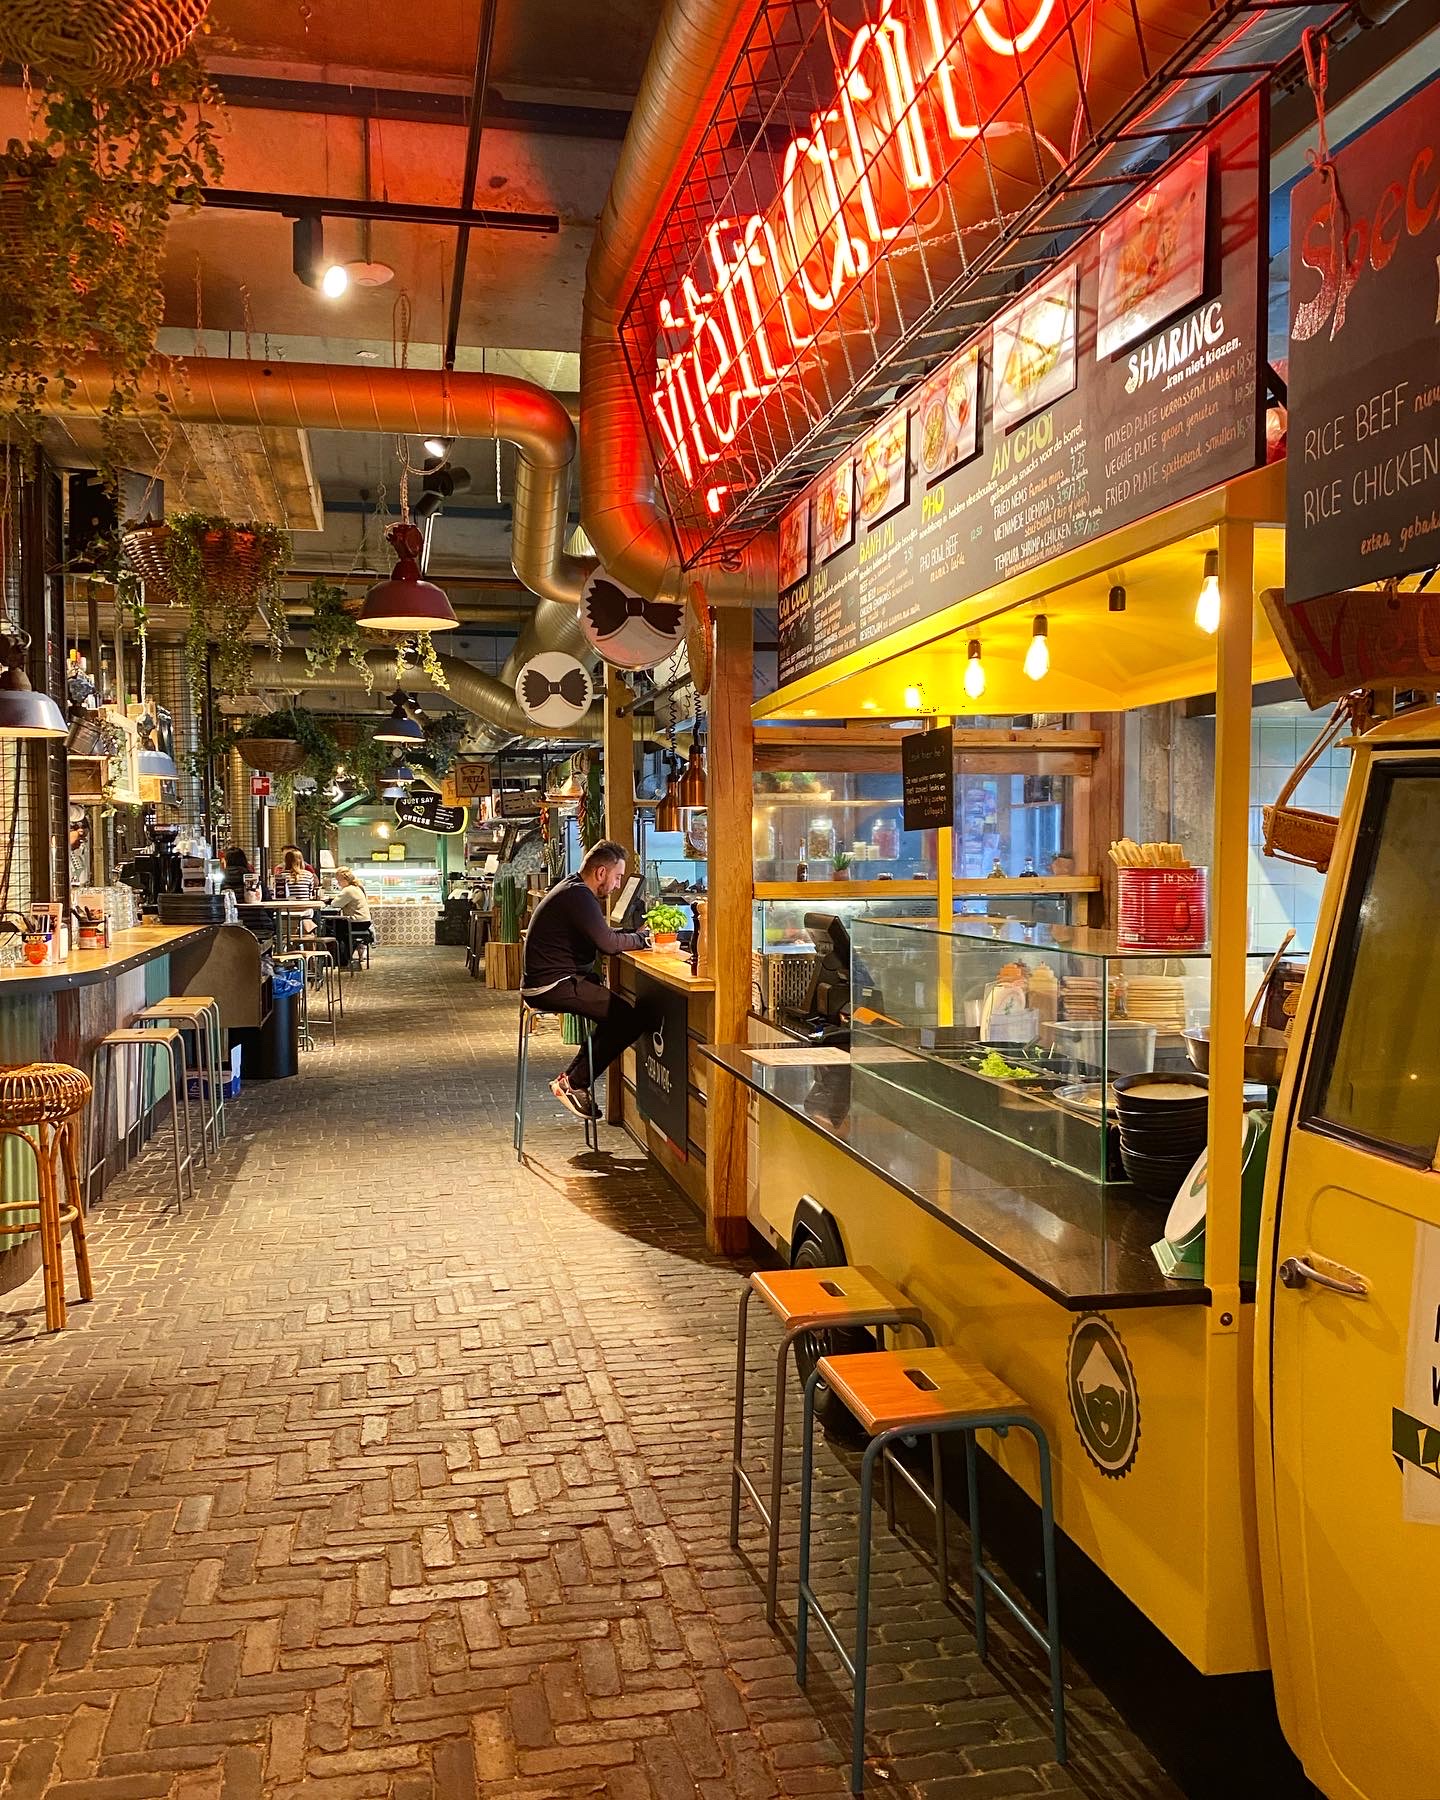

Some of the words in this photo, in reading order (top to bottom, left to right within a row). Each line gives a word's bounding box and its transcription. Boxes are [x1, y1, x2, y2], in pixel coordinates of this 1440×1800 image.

[1291, 145, 1440, 342] Spec
[1124, 302, 1225, 394] SHARING
[1185, 355, 1206, 378] niet
[1205, 336, 1242, 369] kiezen.
[1053, 434, 1063, 452] de
[1104, 421, 1134, 453] MIXED
[1134, 406, 1158, 433] PLATE
[1304, 414, 1344, 464] RICE
[1355, 381, 1408, 441] BEEF
[991, 438, 1011, 481] AN
[1104, 444, 1133, 479] VEGGIE
[1134, 432, 1158, 461] PLATE
[1160, 421, 1184, 452] groen
[1104, 478, 1132, 510] FRIED
[1133, 461, 1158, 496] PLATE
[1204, 427, 1237, 454] smullen
[1303, 478, 1341, 528] RICE
[1352, 438, 1440, 505] CHICKEN
[921, 484, 945, 525] PHO
[993, 497, 1011, 520] FRIED
[993, 510, 1024, 542] VIETNAMESE
[1360, 533, 1391, 556] extra
[993, 545, 1020, 572] TEMPURA
[402, 797, 420, 806] JUST
[420, 796, 434, 805] SAY
[402, 813, 431, 826] CHEESE
